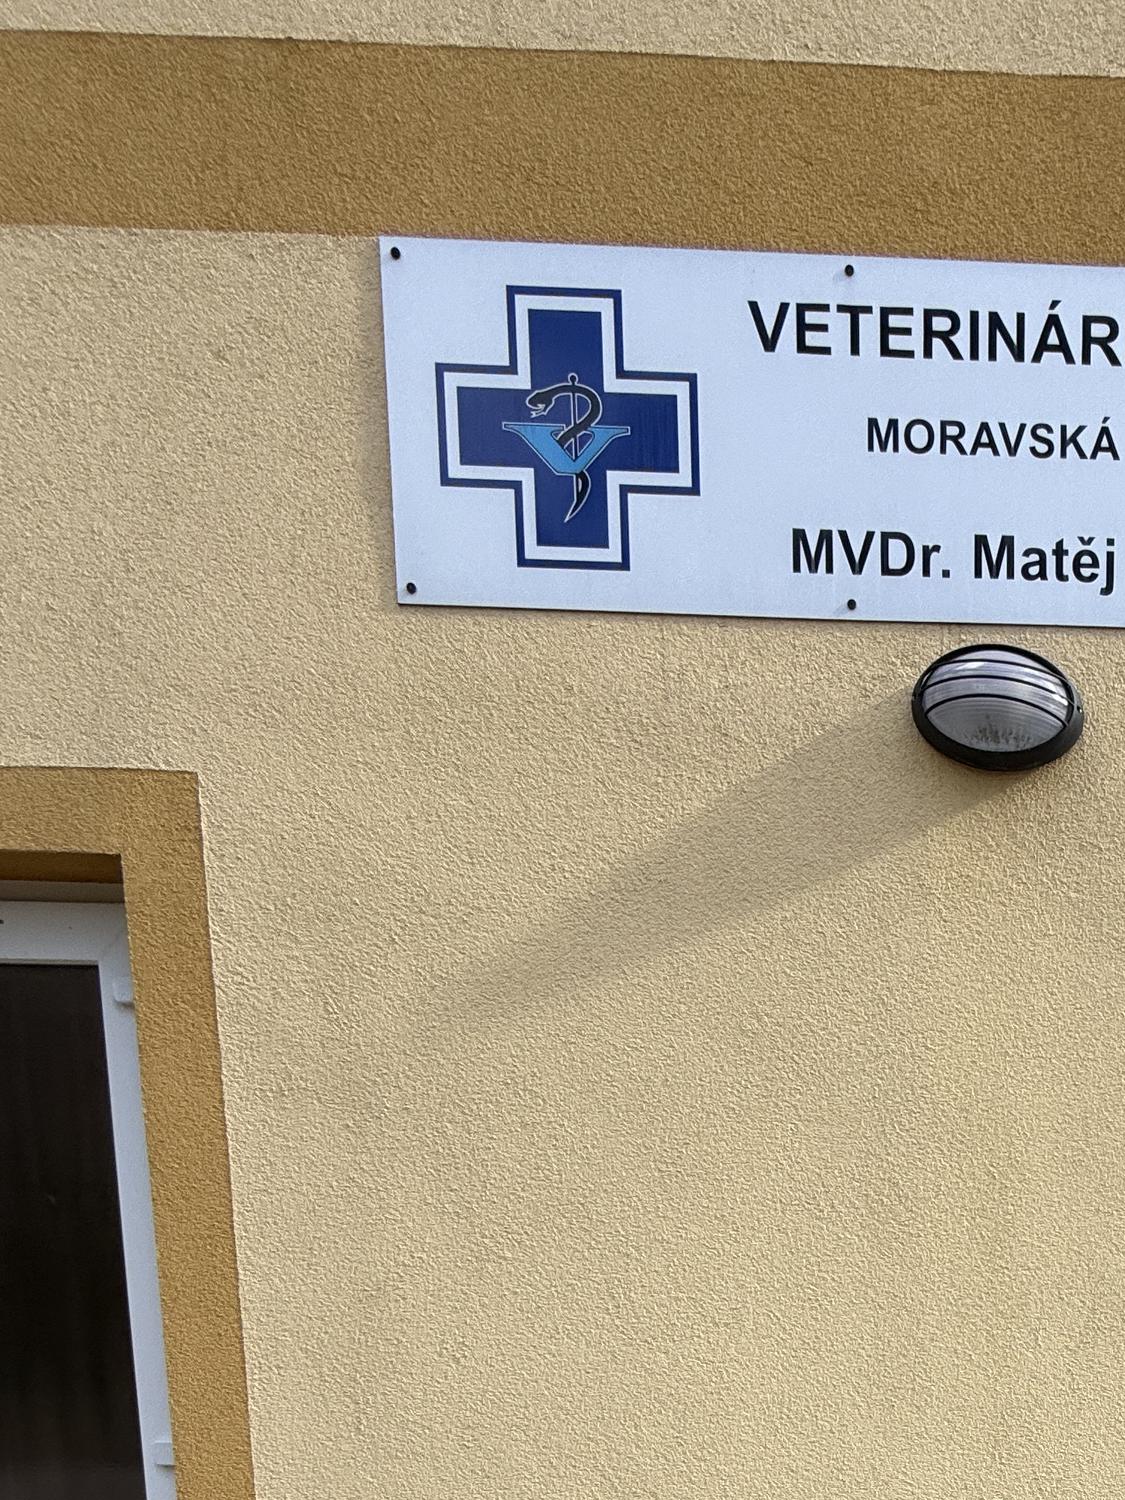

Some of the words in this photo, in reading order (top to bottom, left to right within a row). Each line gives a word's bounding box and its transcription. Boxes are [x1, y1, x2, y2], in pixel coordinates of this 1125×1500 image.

[866, 417, 1119, 461] MORAVSKÁ
[791, 527, 951, 579] MVDr.
[973, 534, 1116, 596] Matěj
